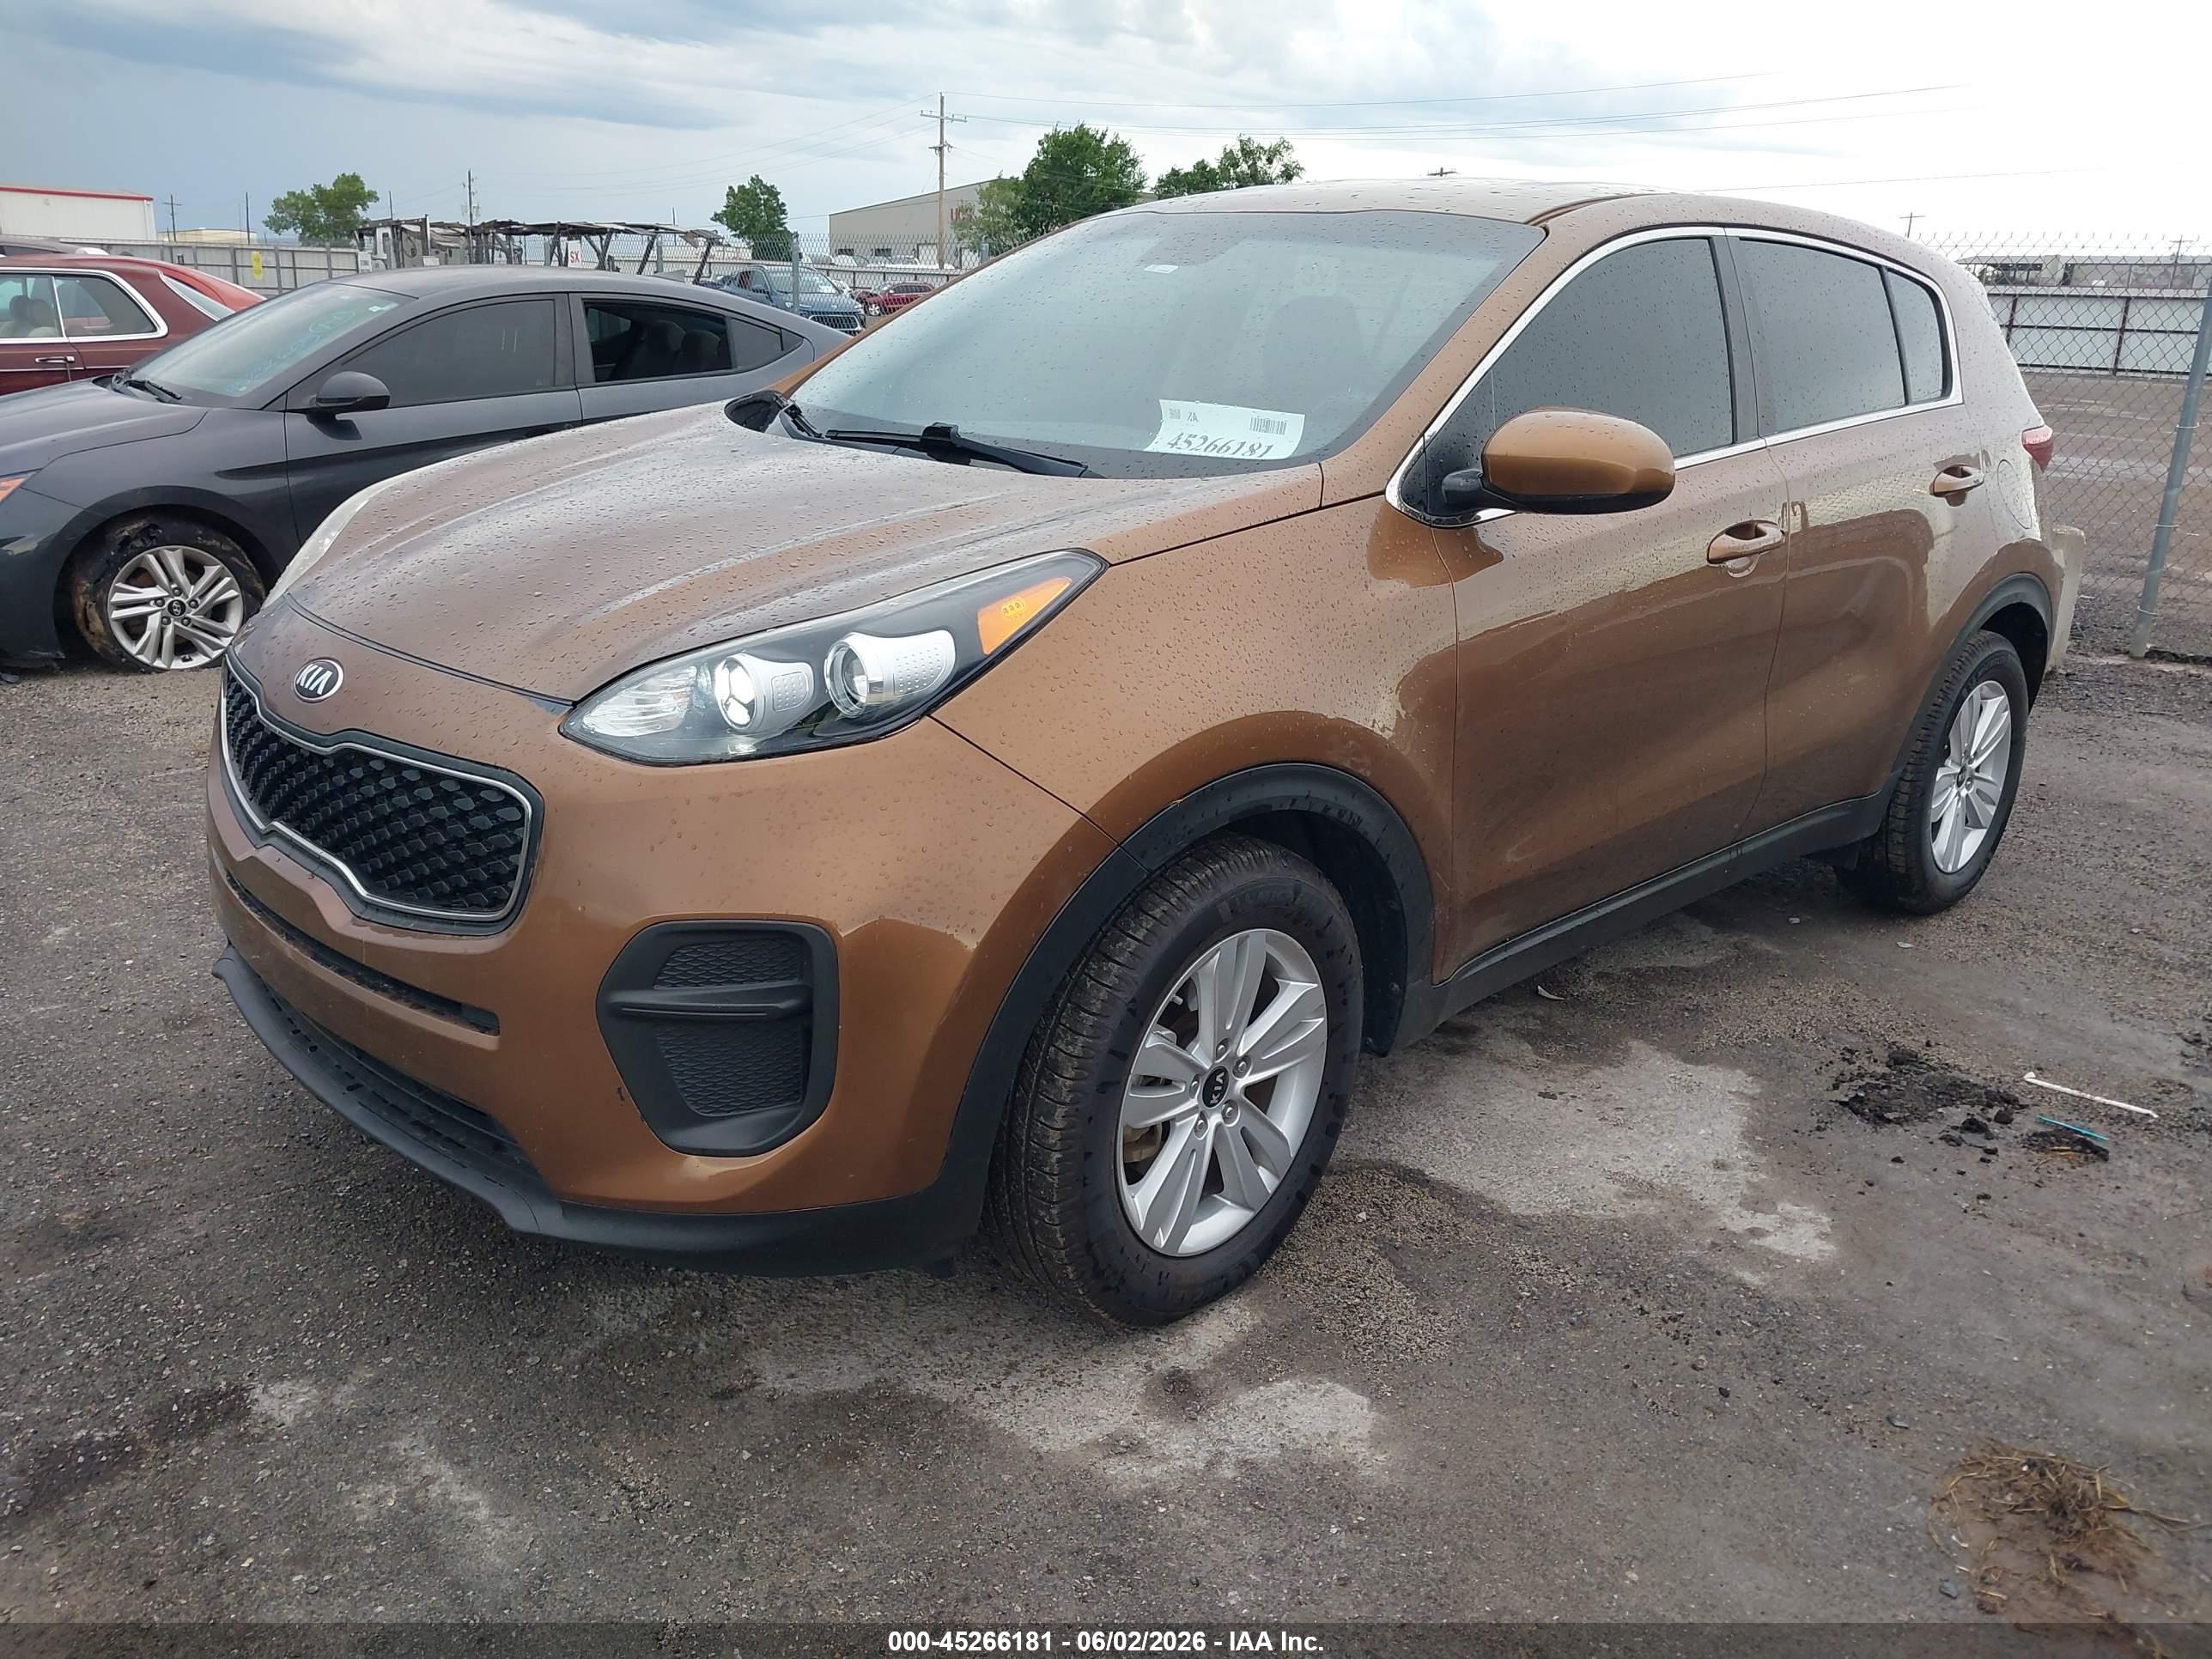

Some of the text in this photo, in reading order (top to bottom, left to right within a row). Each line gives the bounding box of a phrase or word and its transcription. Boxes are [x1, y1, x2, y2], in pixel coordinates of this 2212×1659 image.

[1167, 432, 1274, 458] 45266181
[295, 663, 333, 695] KIA
[1209, 1071, 1225, 1104] KIA
